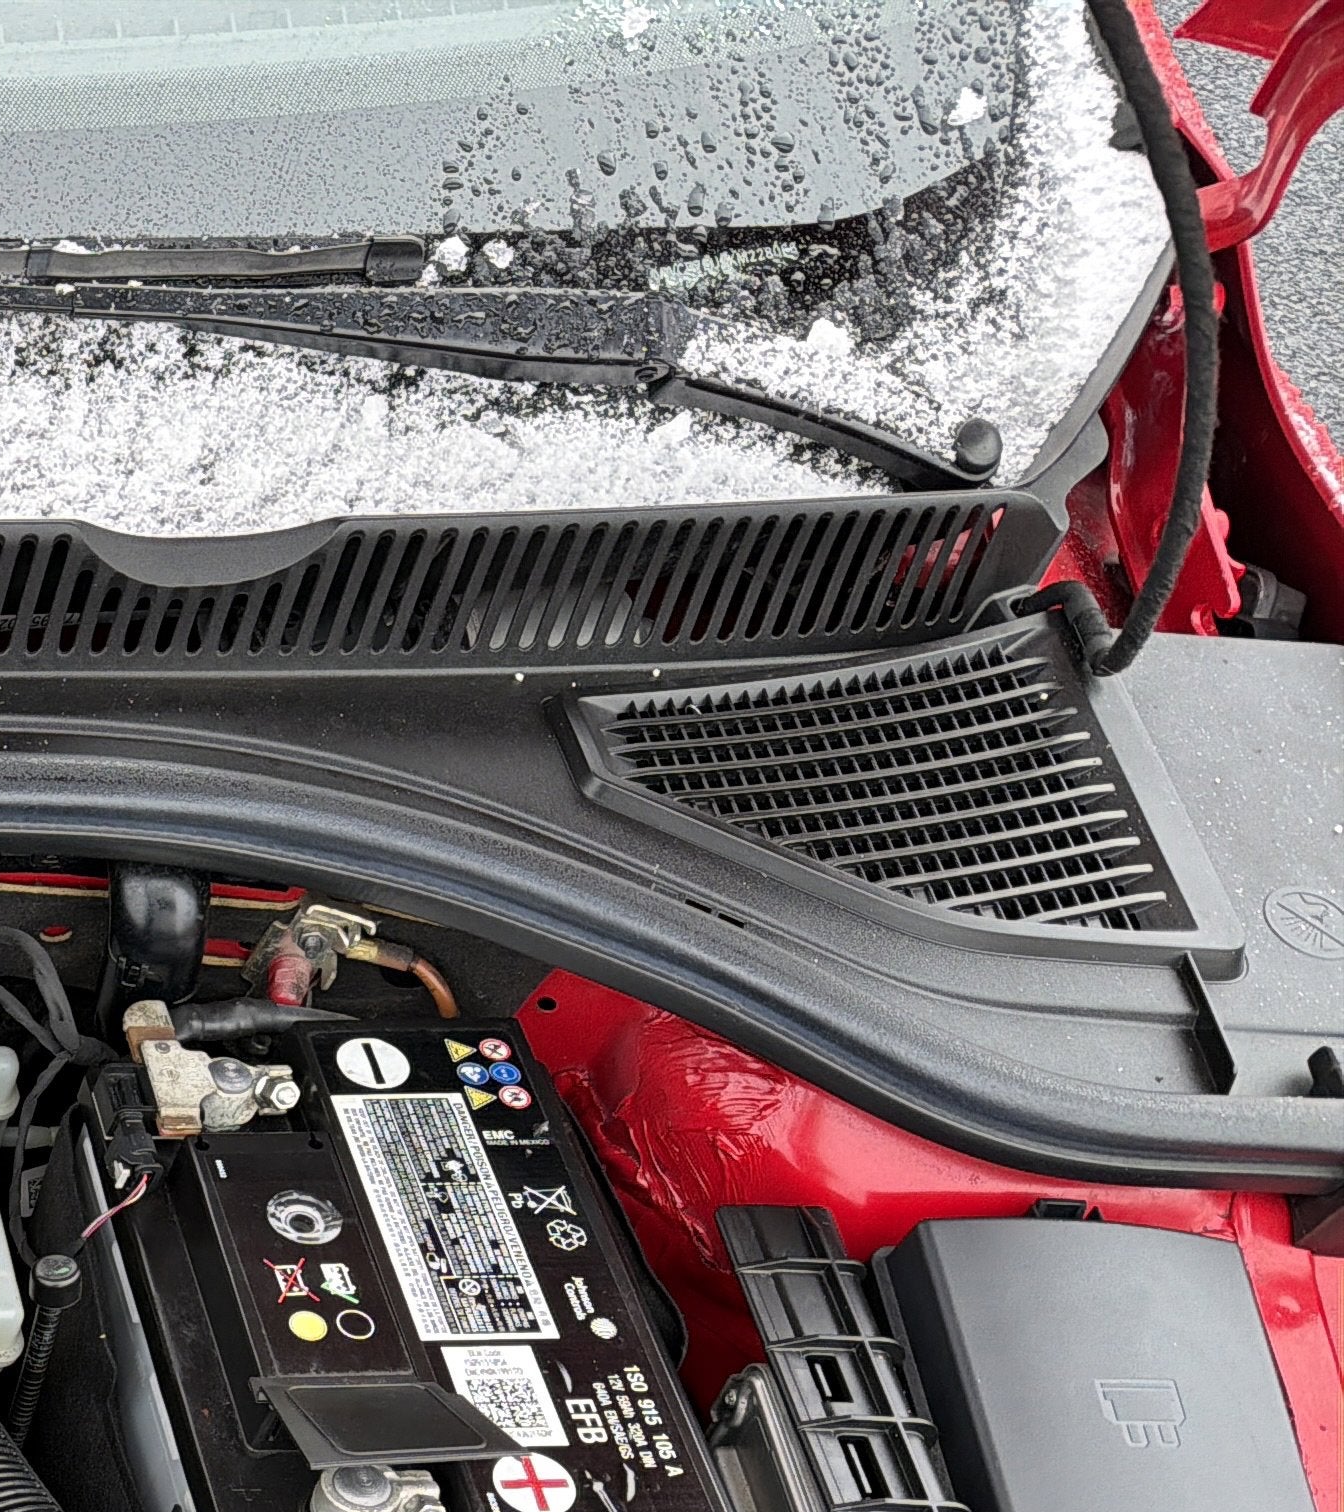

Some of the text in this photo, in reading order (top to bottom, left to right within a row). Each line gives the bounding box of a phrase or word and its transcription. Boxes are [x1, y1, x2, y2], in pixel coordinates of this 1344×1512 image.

[482, 1130, 515, 1139] EMC
[508, 1193, 523, 1208] Pb
[563, 1282, 588, 1321] Controls
[571, 1276, 596, 1316] Johnson
[565, 1399, 609, 1444] EFB
[637, 1399, 663, 1426] 915
[653, 1433, 677, 1460] 105
[665, 1465, 685, 1477] A
